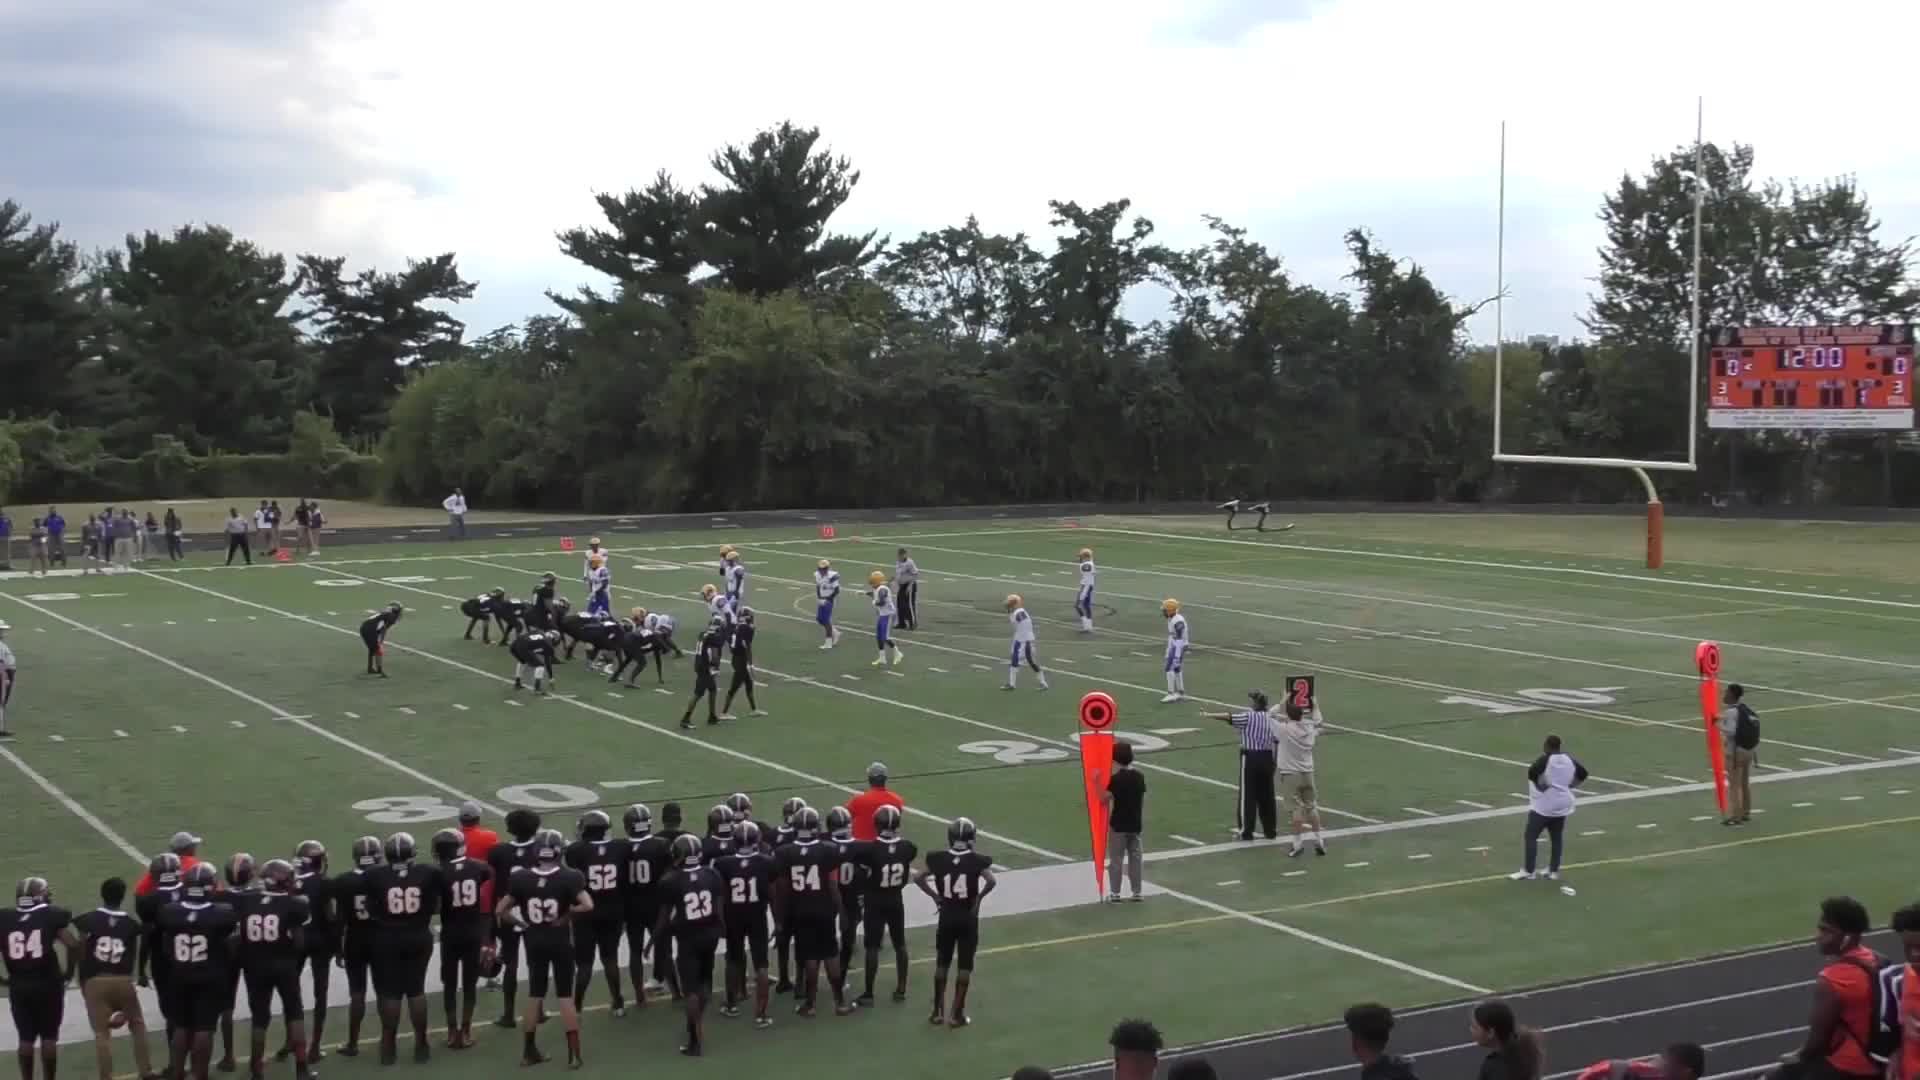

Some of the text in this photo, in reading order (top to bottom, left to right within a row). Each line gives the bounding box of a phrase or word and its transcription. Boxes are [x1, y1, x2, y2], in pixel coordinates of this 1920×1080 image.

[1727, 359, 1739, 376] 0
[1782, 347, 1842, 368] 12:00
[1894, 357, 1906, 375] 0
[1292, 679, 1310, 708] 2
[588, 864, 617, 890] 52
[628, 860, 651, 885] 10
[791, 865, 821, 891] 54
[880, 863, 905, 888] 12
[387, 886, 421, 914] 66
[451, 879, 478, 908] 19
[730, 876, 759, 903] 21
[944, 874, 968, 899] 14
[527, 897, 559, 924] 63
[684, 891, 713, 920] 23
[247, 913, 280, 942] 68
[7, 929, 43, 960] 64
[174, 933, 208, 962] 62
